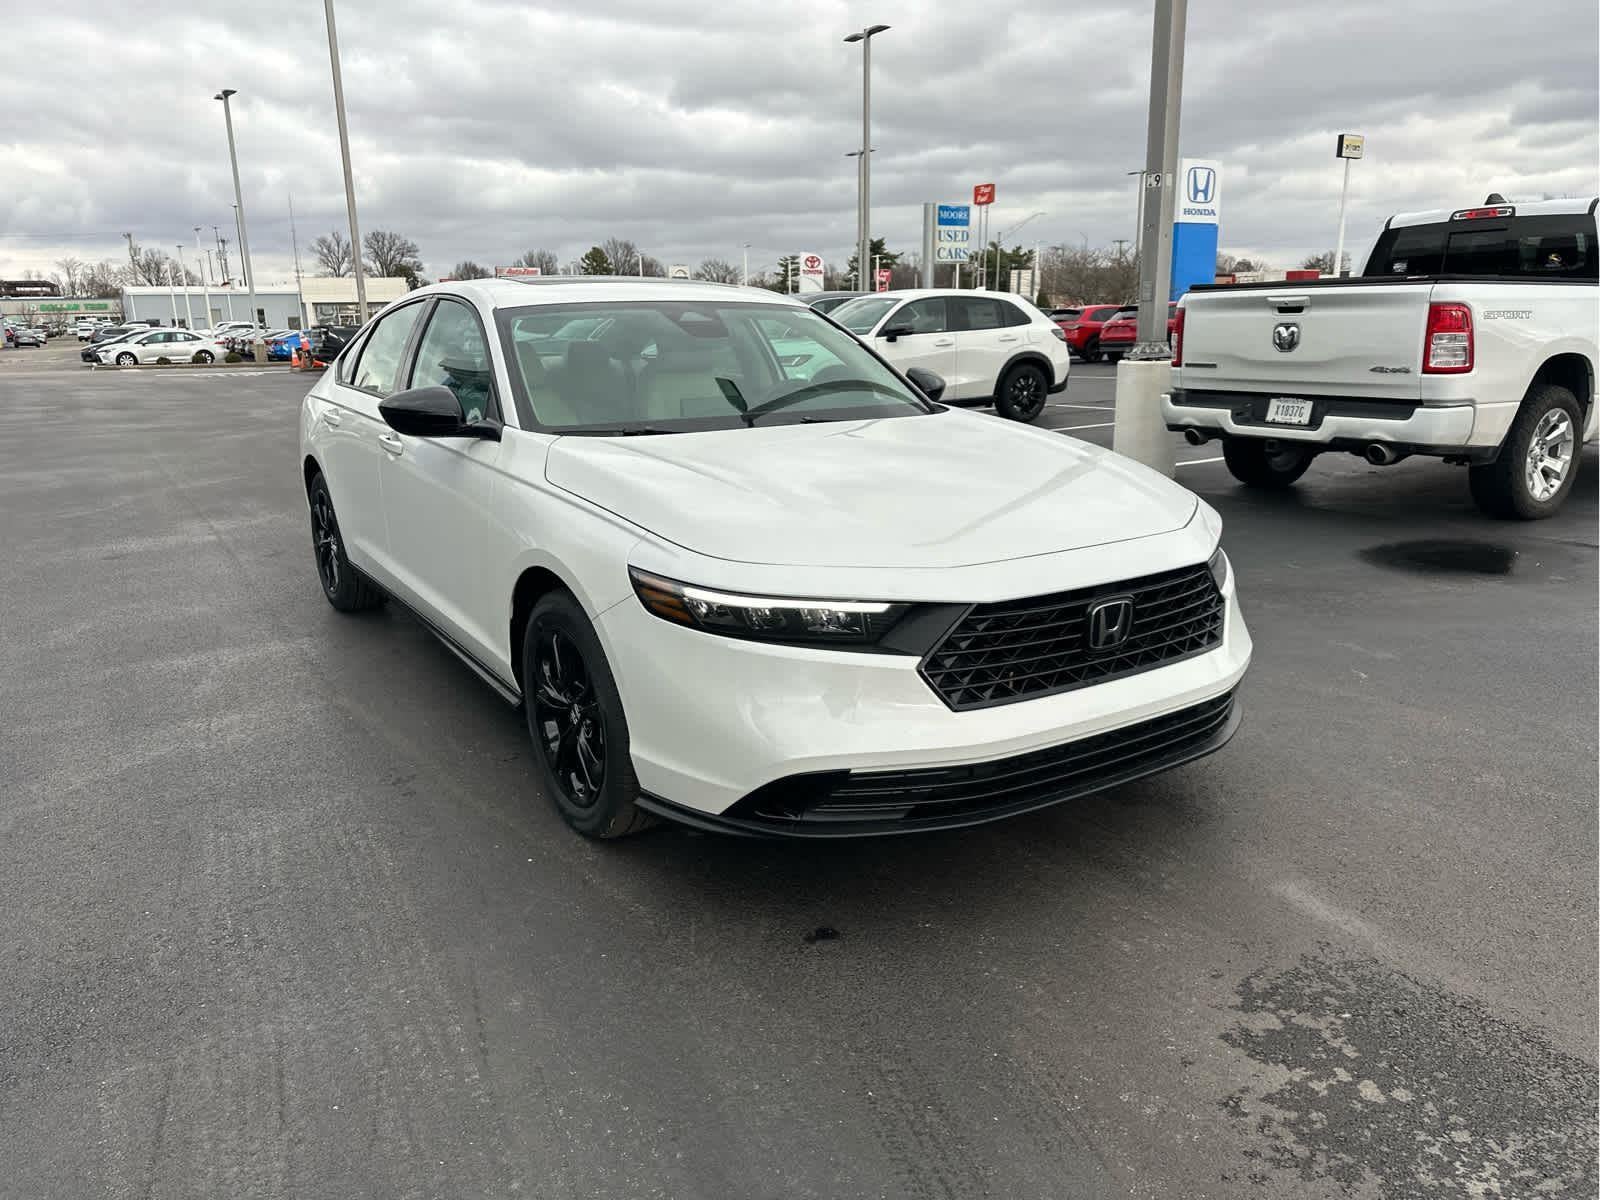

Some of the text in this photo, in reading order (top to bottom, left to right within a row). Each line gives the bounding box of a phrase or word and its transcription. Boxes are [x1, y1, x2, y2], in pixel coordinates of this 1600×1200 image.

[939, 210, 969, 220] MOORE
[1183, 208, 1217, 216] HONDA
[938, 230, 969, 242] USED
[937, 247, 969, 260] CARS
[1483, 310, 1533, 320] SPORT
